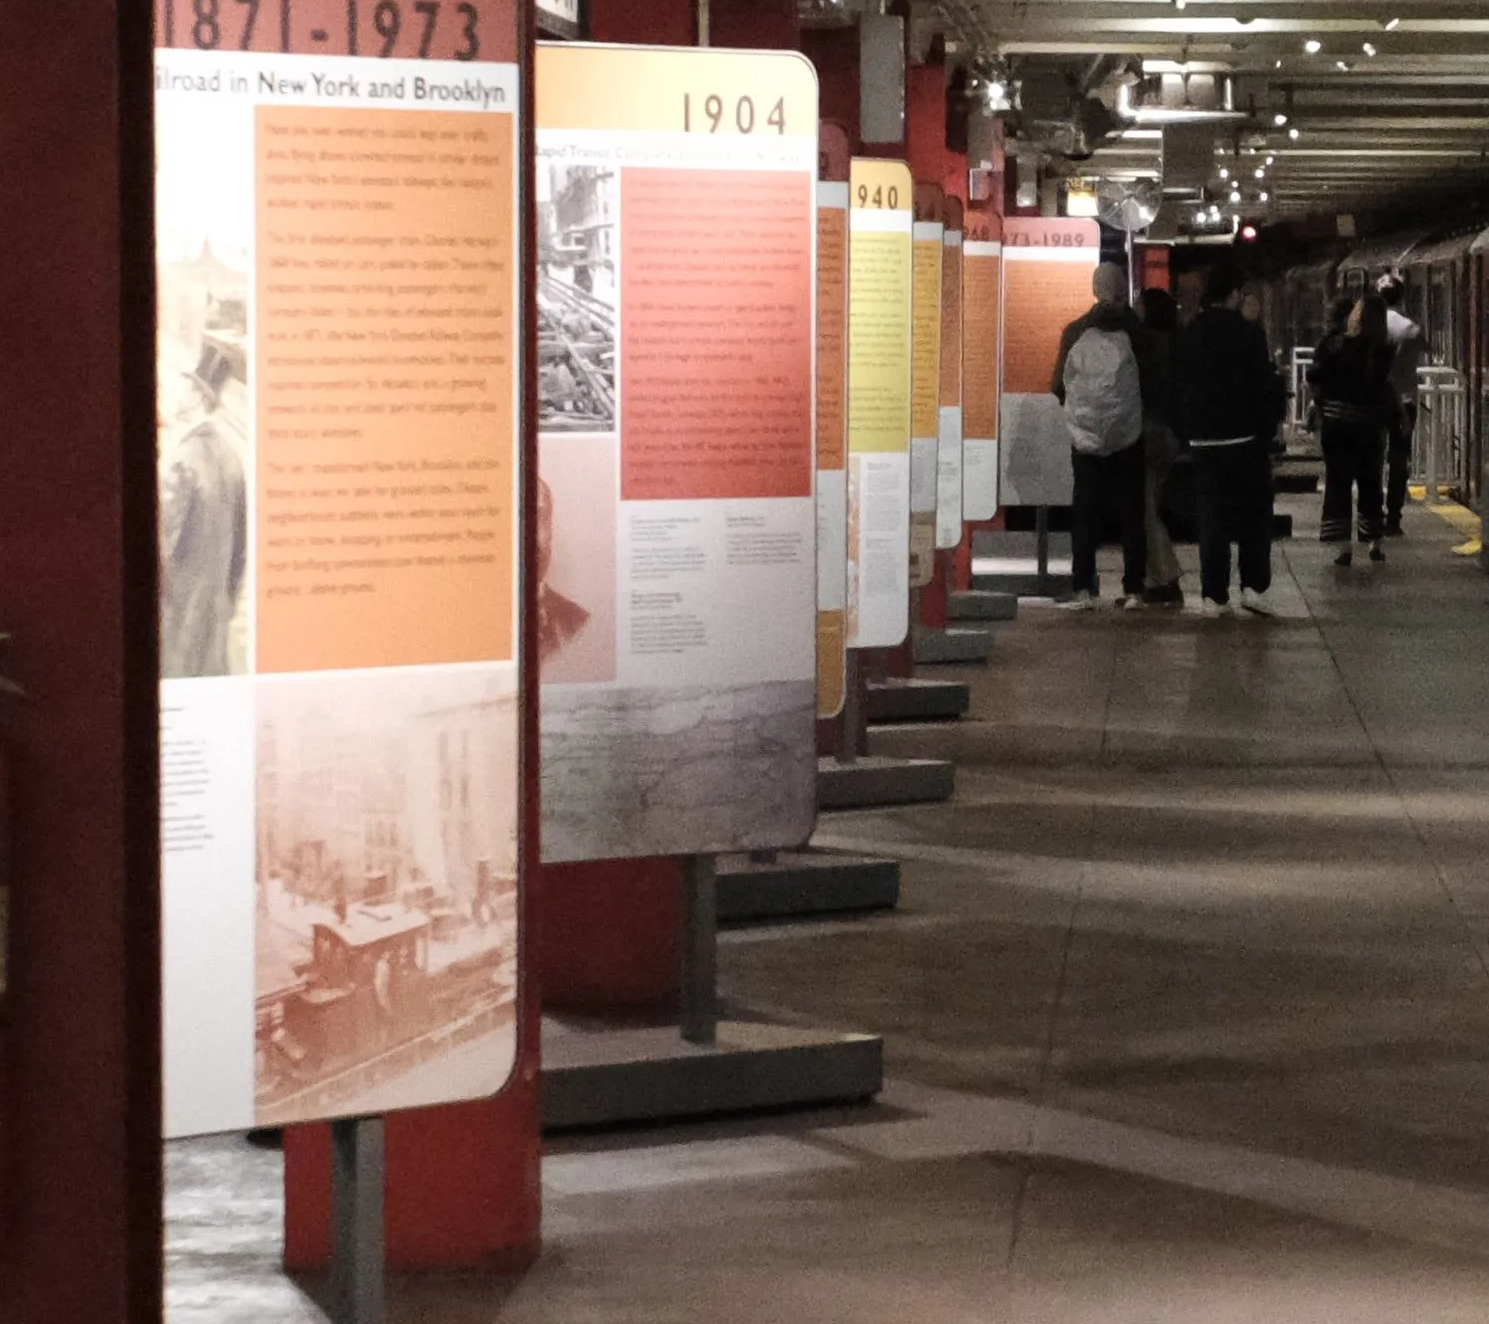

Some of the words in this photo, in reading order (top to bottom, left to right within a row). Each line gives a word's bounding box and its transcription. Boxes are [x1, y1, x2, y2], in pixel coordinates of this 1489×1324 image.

[258, 71, 307, 96] New
[310, 72, 359, 98] York
[368, 75, 406, 101] and
[413, 77, 506, 111] Brooklyn
[682, 91, 787, 136] 1904
